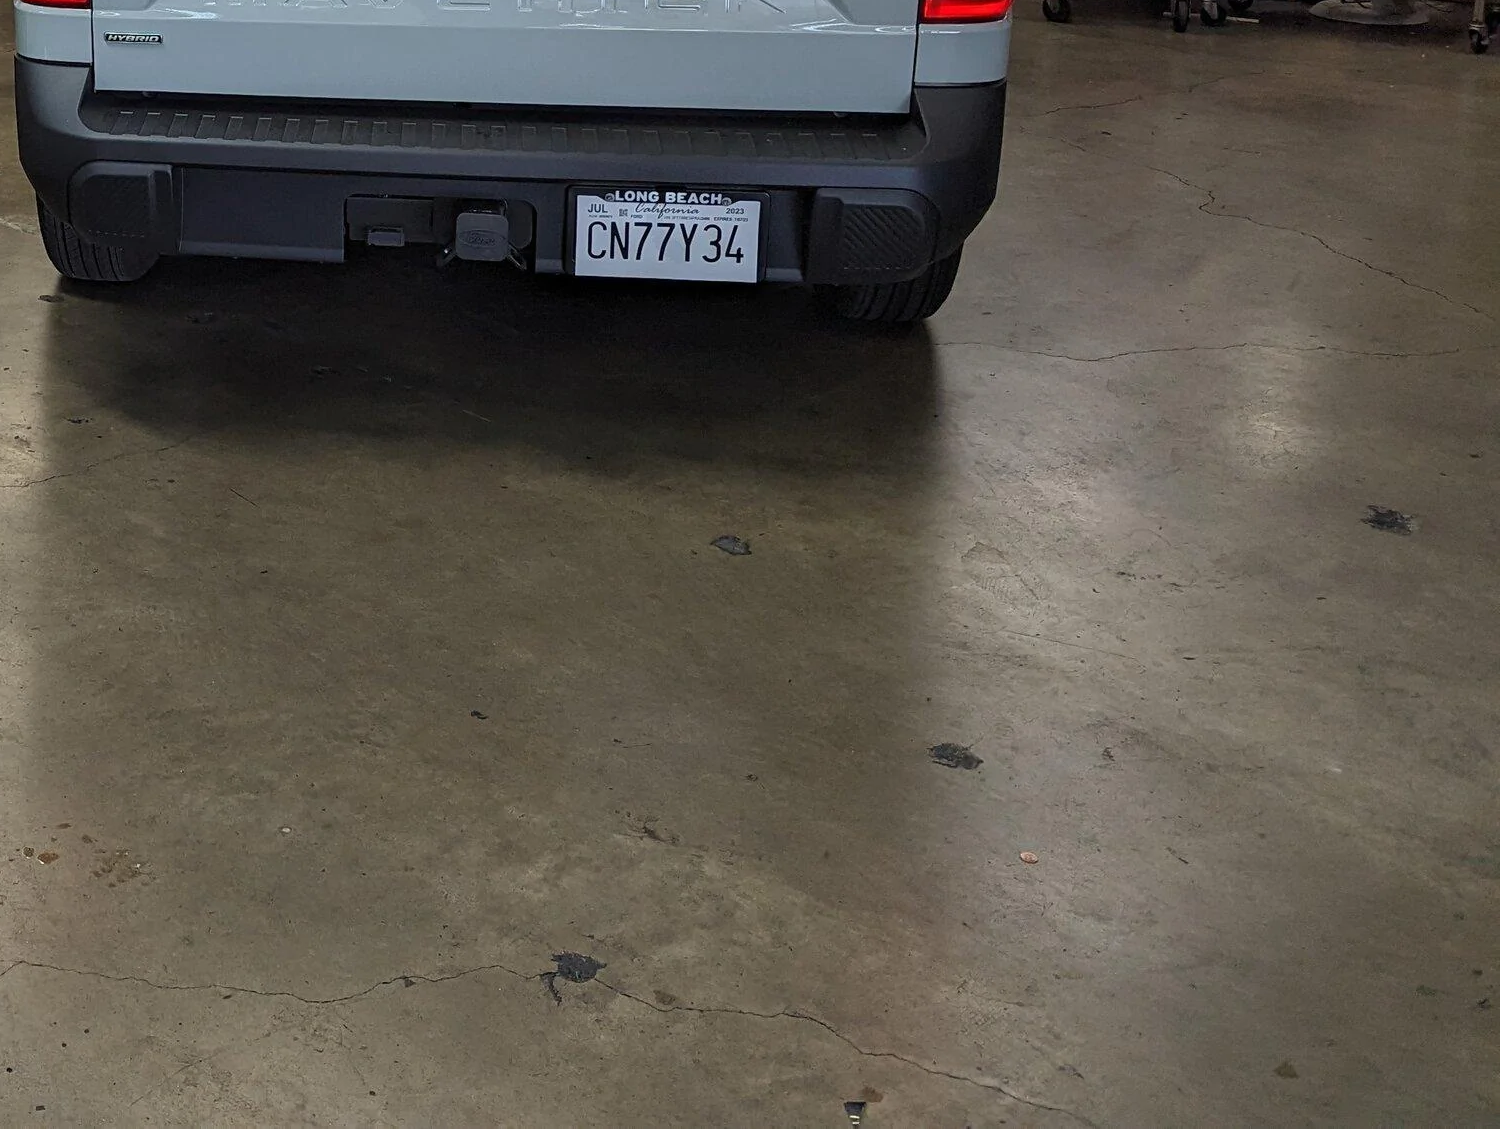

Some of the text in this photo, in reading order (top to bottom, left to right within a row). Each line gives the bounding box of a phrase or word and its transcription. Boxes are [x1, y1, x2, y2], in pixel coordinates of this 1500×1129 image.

[107, 34, 159, 42] HYBRID
[615, 190, 723, 205] LONG BEACH
[588, 203, 608, 214] JUL
[635, 202, 700, 219] California
[725, 207, 745, 215] 2023
[587, 221, 744, 264] CN77Y34
